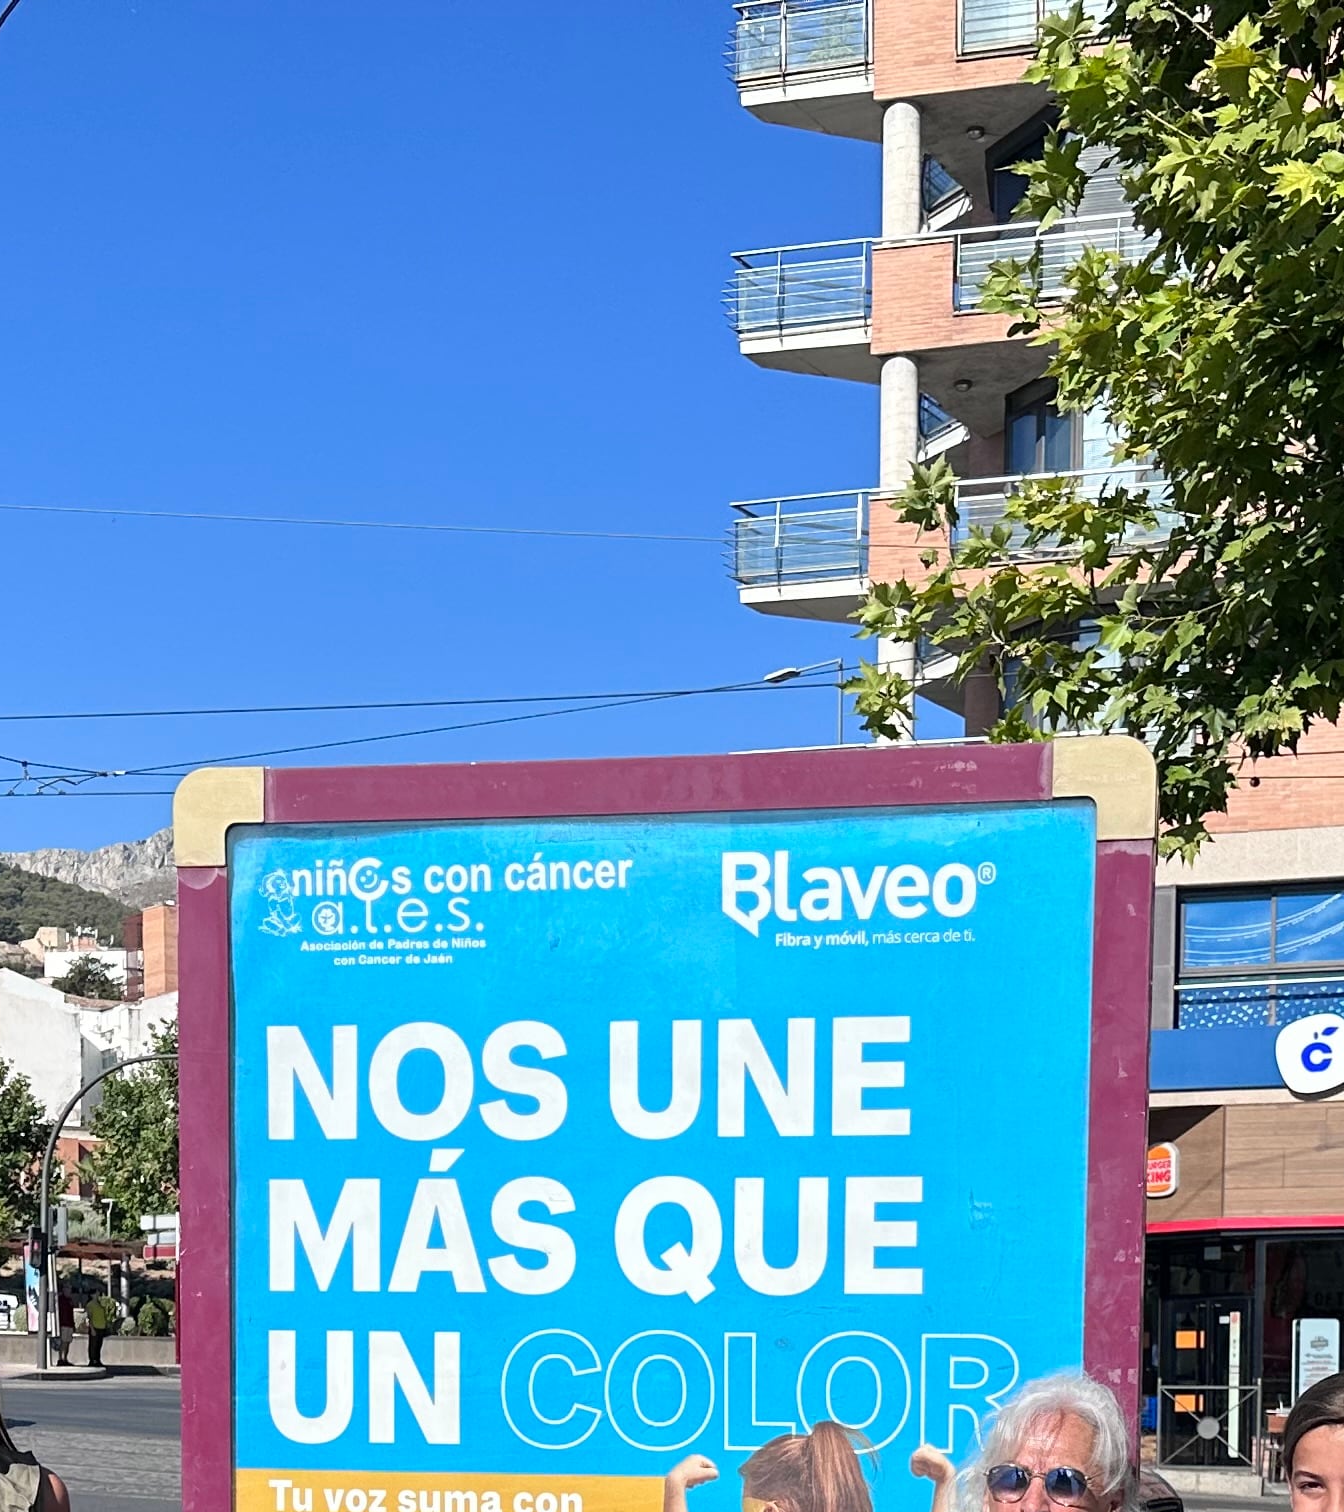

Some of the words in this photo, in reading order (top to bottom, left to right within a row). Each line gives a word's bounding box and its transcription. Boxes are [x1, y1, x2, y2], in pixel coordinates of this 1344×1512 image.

[424, 865, 492, 894] con
[504, 852, 634, 892] cáncer
[300, 939, 366, 952] Asociación
[369, 939, 385, 951] de
[388, 938, 430, 950] Padres
[432, 938, 449, 950] de
[451, 936, 487, 949] Niños
[776, 932, 810, 948] Fibra
[813, 934, 822, 949] y
[826, 931, 869, 946] móvil,
[872, 932, 902, 944] más
[904, 930, 940, 944] cerca
[943, 930, 960, 942] de
[334, 955, 355, 966] con
[405, 953, 422, 964] de
[424, 952, 453, 964] Jaén
[267, 1020, 567, 1141] NOS
[610, 1016, 910, 1139] UNE
[269, 1149, 576, 1295] MÁS
[615, 1176, 923, 1303] QUE
[268, 1329, 461, 1445] UN
[501, 1328, 1022, 1454] COLOR
[269, 1479, 312, 1512] Tu
[324, 1489, 386, 1512] voz
